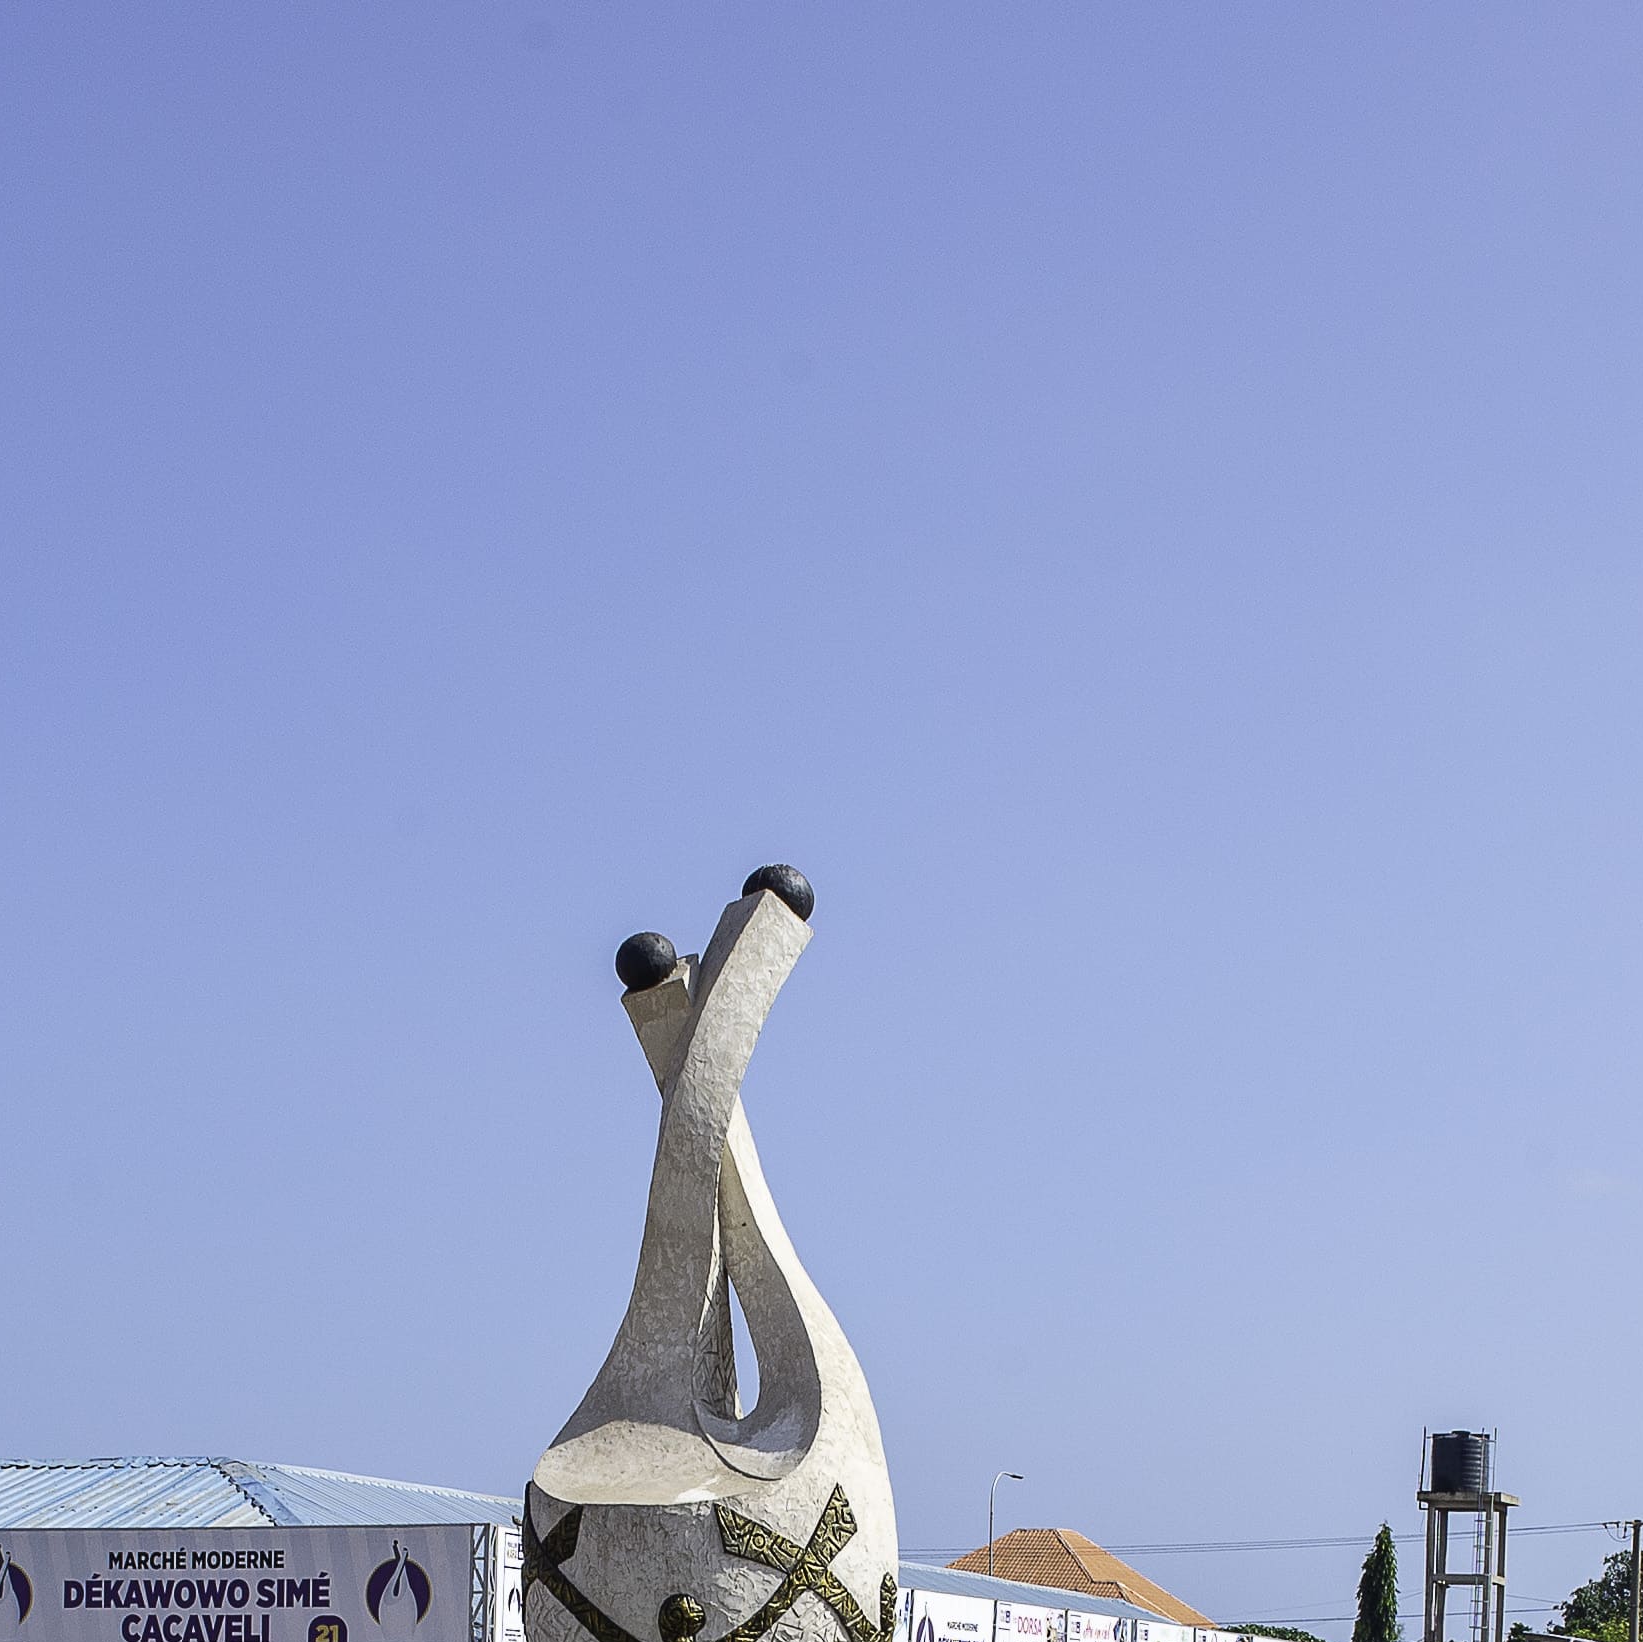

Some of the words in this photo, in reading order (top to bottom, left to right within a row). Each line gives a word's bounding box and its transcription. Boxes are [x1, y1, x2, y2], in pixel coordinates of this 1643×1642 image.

[109, 1547, 186, 1570] MARCHÉ
[191, 1550, 285, 1570] MODERNE
[63, 1573, 250, 1609] DÉKAWOWO
[256, 1571, 331, 1608] SIMÉ
